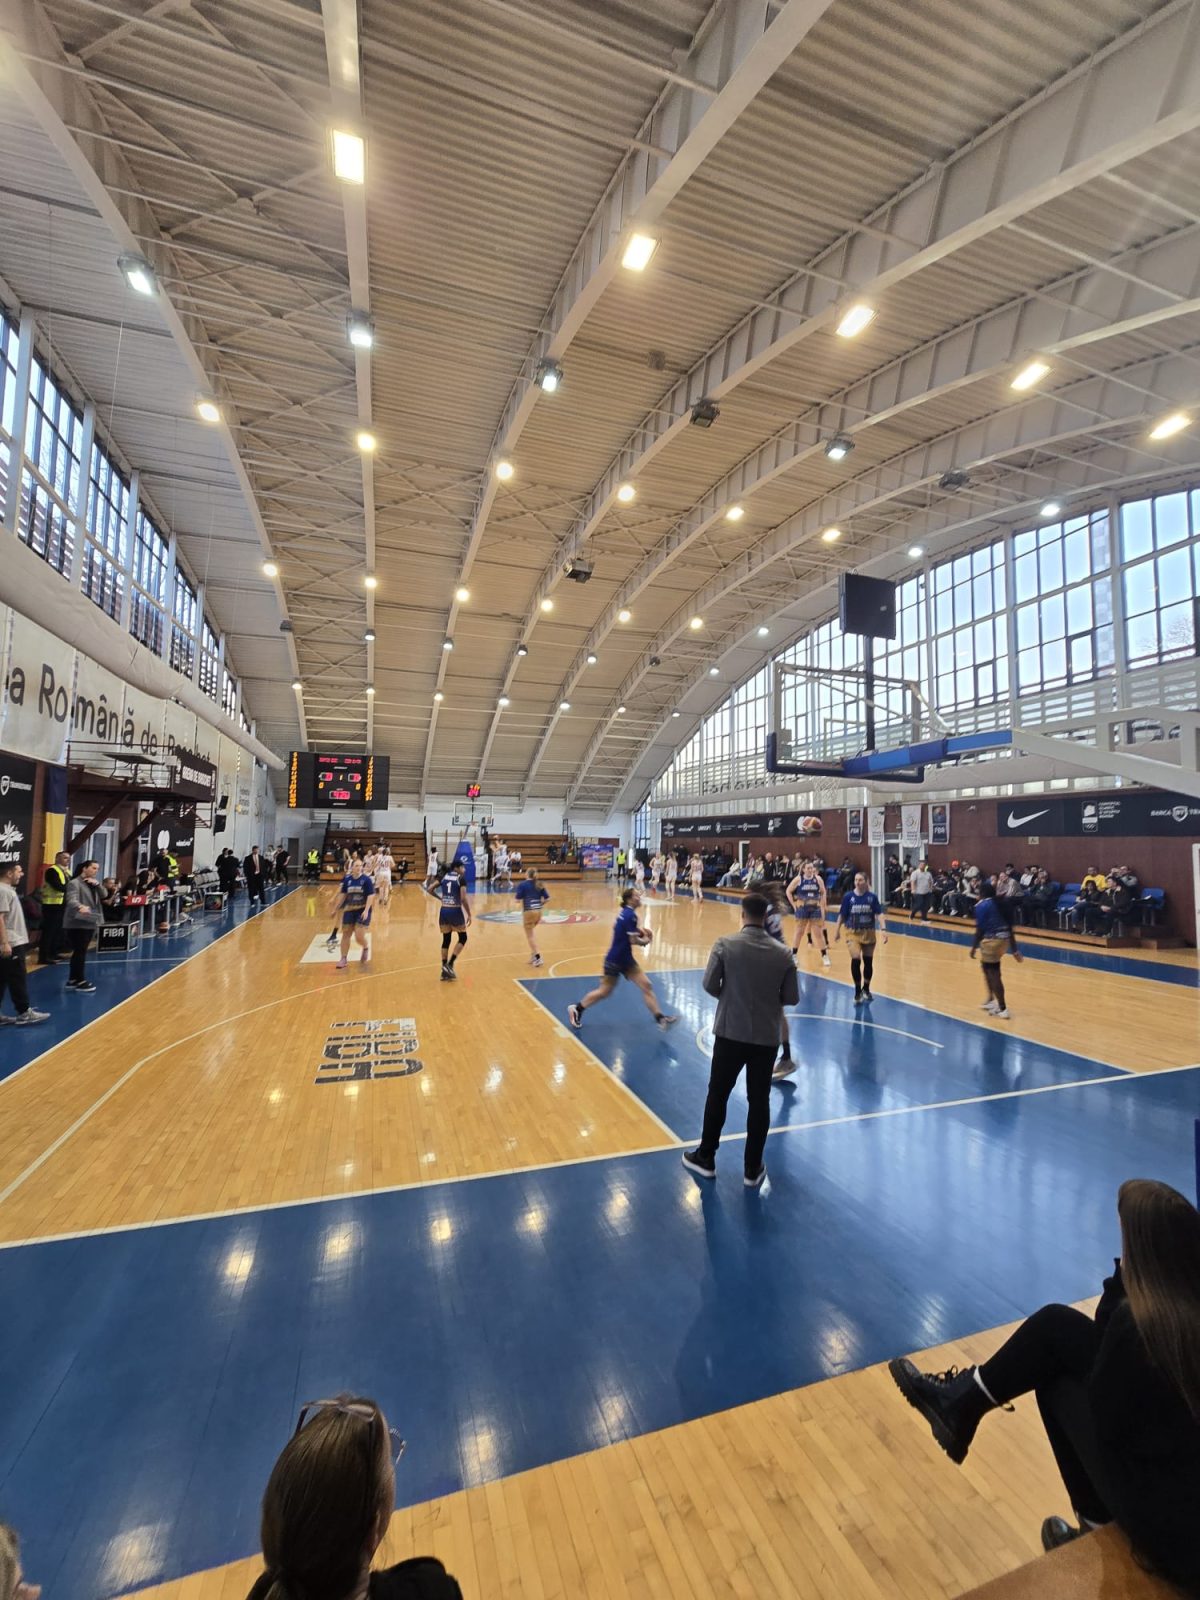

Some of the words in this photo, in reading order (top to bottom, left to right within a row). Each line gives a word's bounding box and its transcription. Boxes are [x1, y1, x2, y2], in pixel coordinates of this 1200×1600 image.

[38, 663, 134, 749] Română
[140, 721, 158, 756] de
[446, 881, 452, 893] 1
[103, 928, 125, 938] FIBA
[314, 1017, 425, 1085] FIBA
